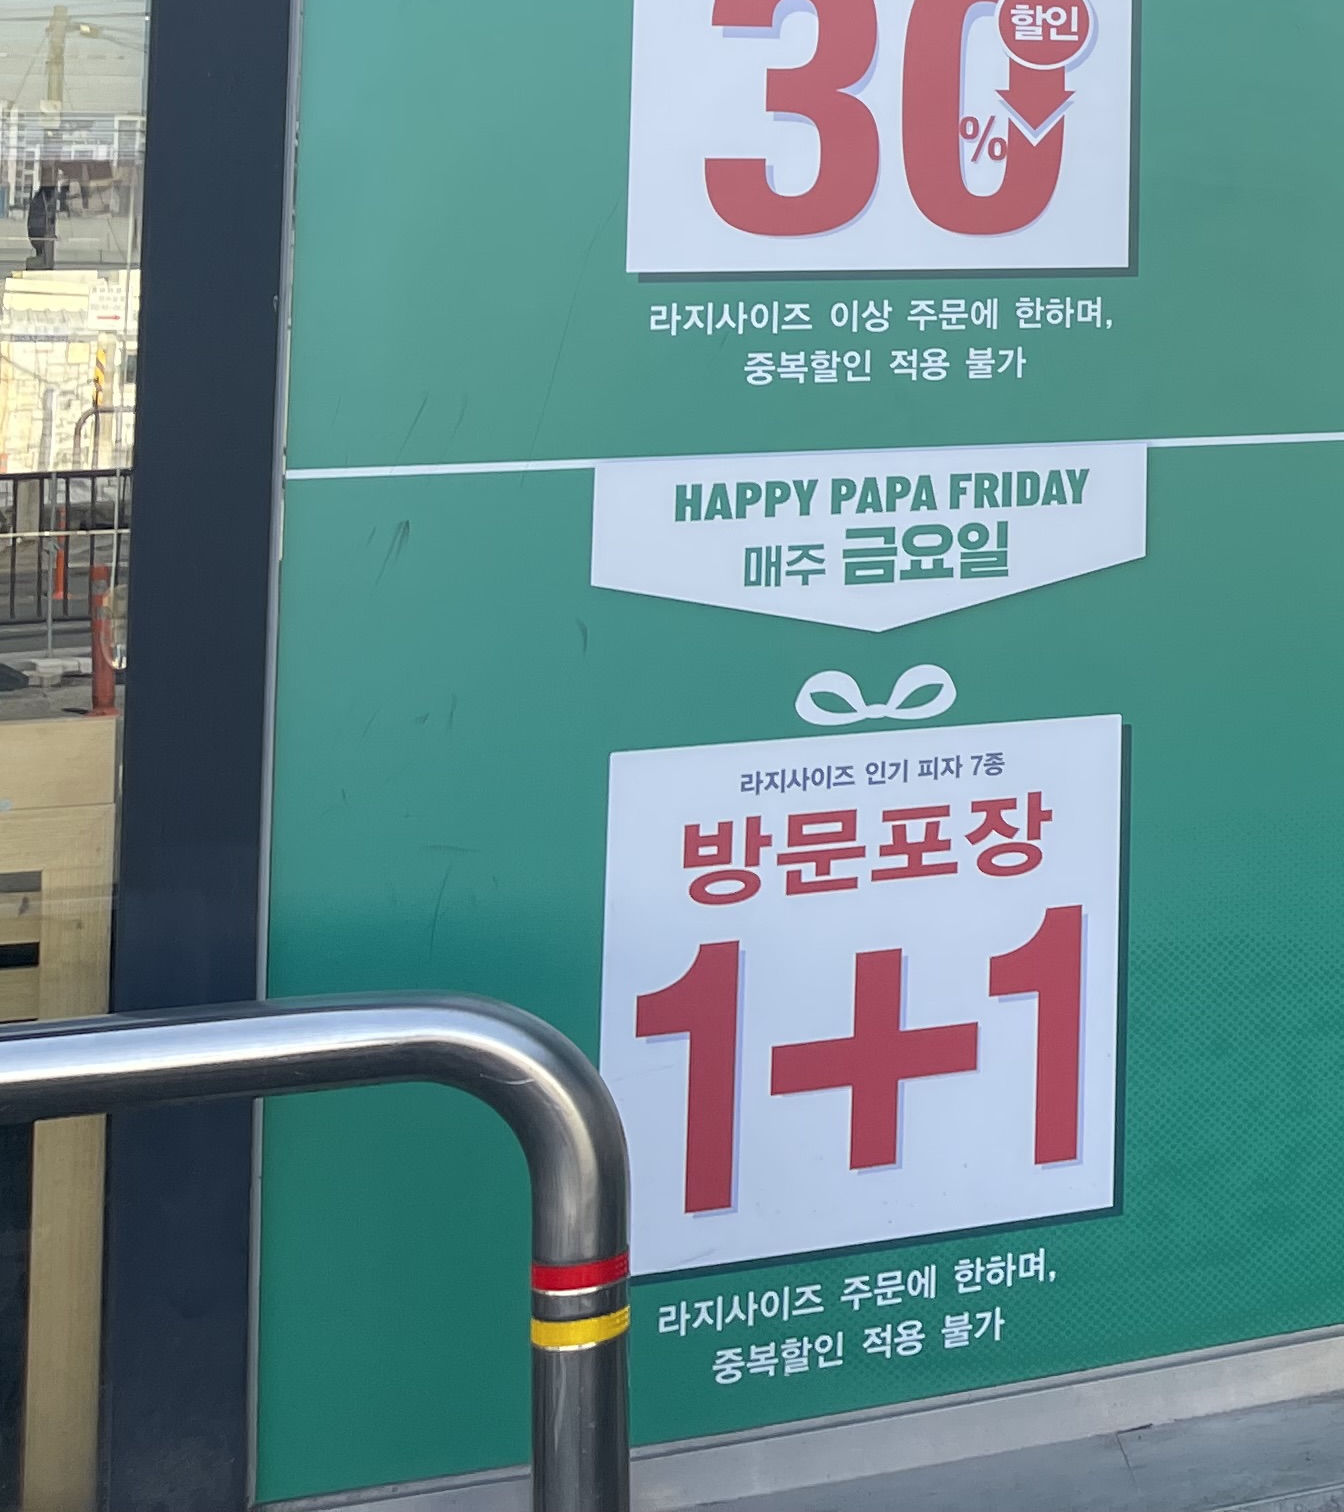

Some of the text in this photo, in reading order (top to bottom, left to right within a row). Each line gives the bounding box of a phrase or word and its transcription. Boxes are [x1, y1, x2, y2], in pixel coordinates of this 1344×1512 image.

[1008, 3, 1080, 42] 할인
[648, 294, 1114, 337] 라지사이즈 이상 주문에 한하며,
[742, 345, 1027, 387] 중복할인 적용 불가
[674, 468, 1090, 523] HAPPY PAPA FRIDAY
[743, 520, 1010, 588] 매주 금요일
[739, 751, 1006, 797] 라지사이즈 인기 피자 7종
[681, 790, 1054, 907] 방문포장
[635, 904, 1088, 1216] 1+1
[657, 1246, 1057, 1338] 라지사이즈 주문에 한하며,
[711, 1305, 1005, 1385] 중복할인 적용 불가
